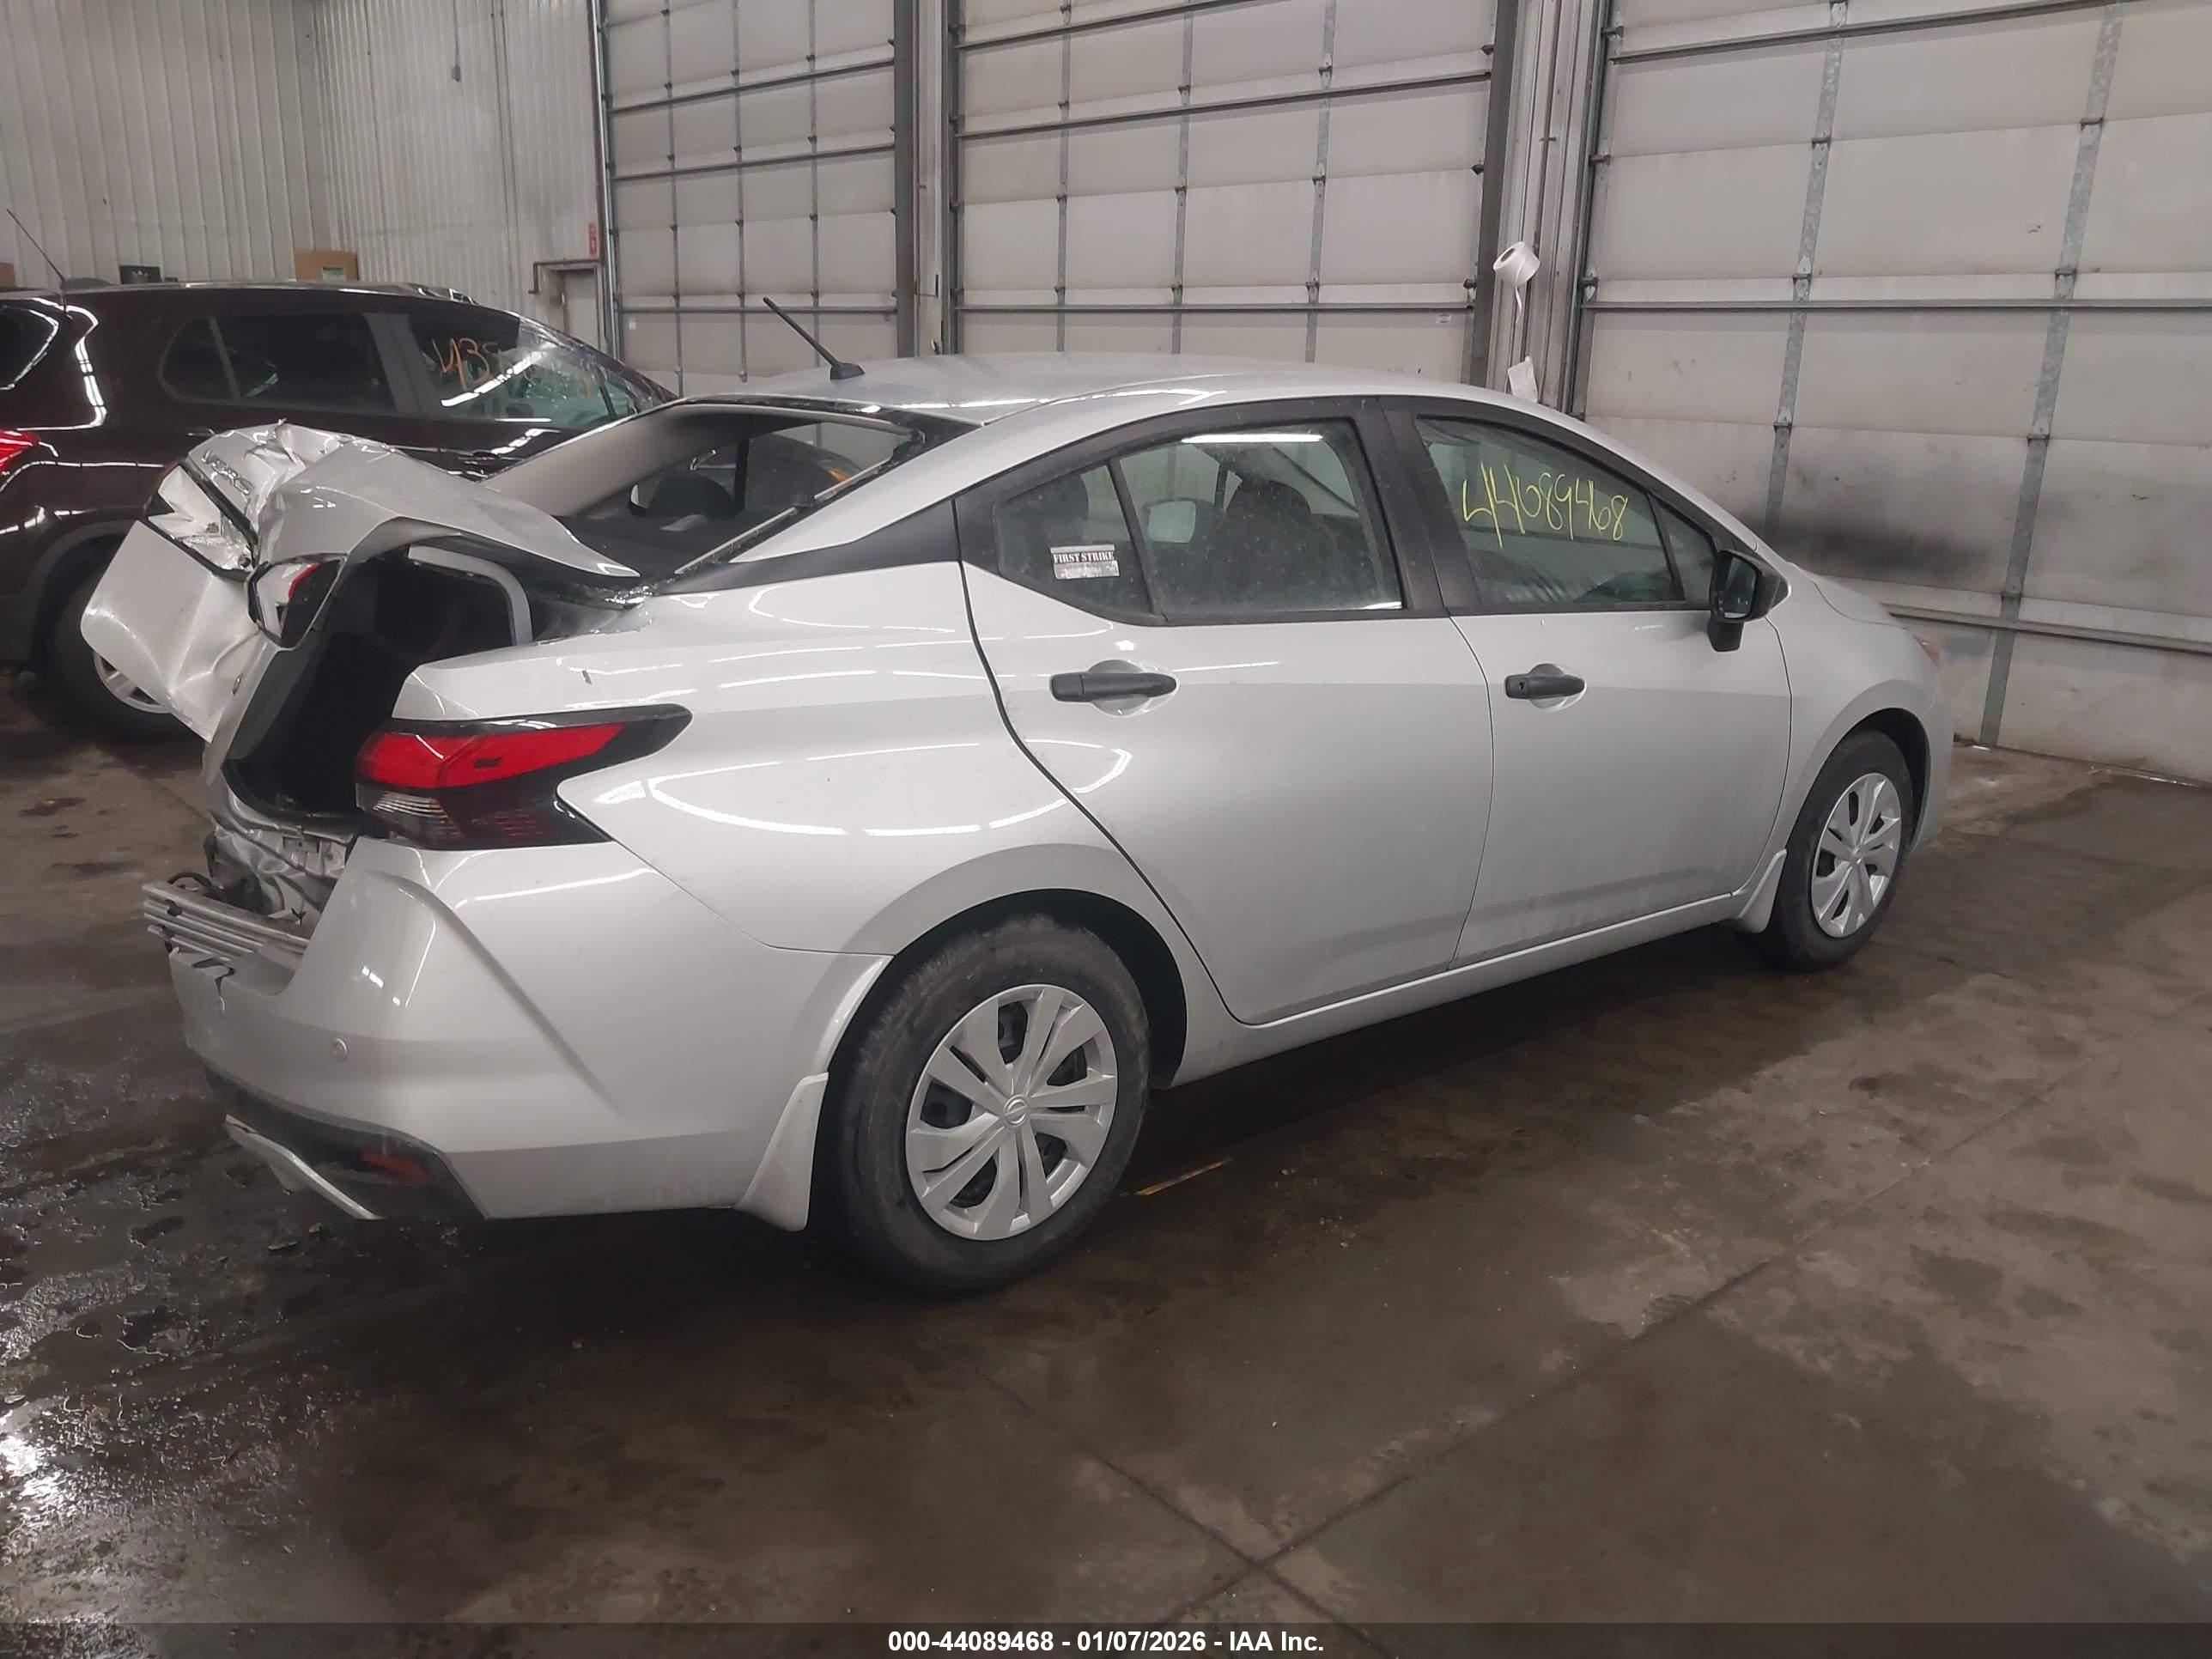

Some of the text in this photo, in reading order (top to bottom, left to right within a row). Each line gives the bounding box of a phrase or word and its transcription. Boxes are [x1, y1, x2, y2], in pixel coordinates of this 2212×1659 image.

[1462, 460, 1628, 550] 44089468
[1053, 550, 1115, 564] FIRST STRIKE
